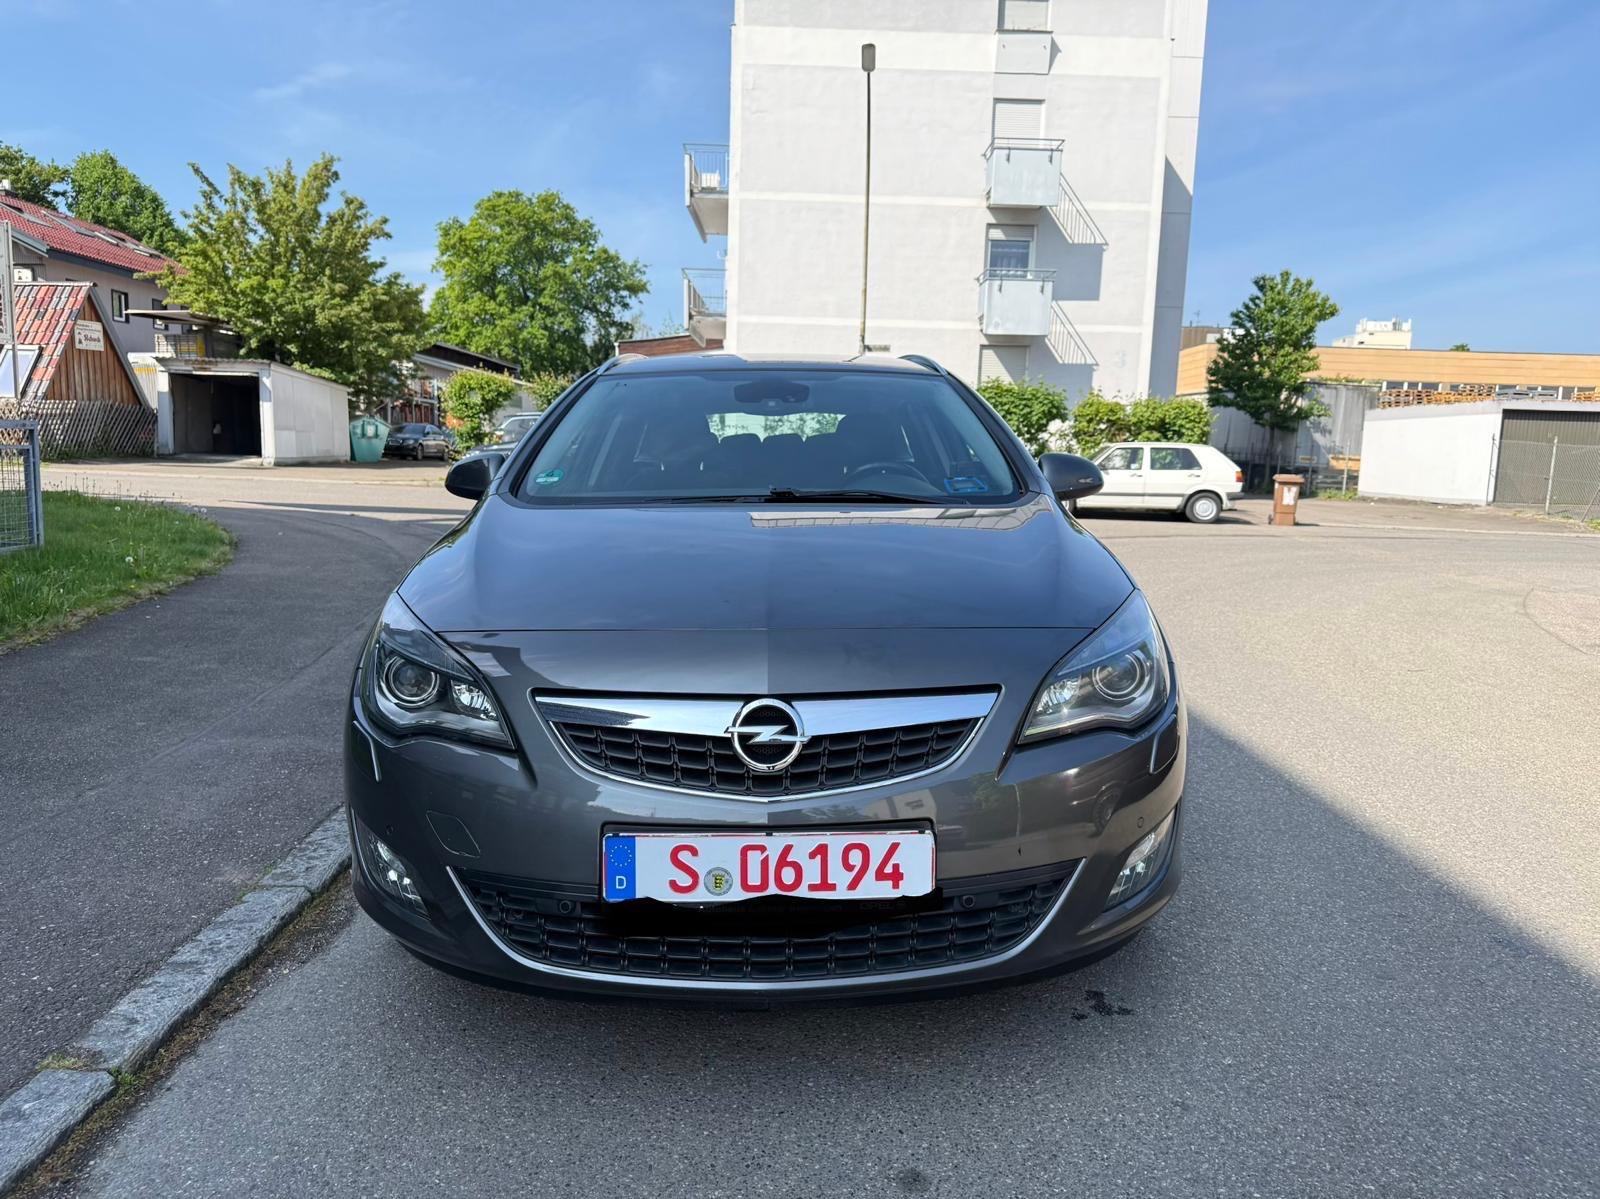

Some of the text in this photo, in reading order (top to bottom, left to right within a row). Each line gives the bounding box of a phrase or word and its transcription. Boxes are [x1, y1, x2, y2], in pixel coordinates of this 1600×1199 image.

[615, 875, 627, 889] D
[668, 843, 700, 894] S
[739, 841, 904, 894] 06194
